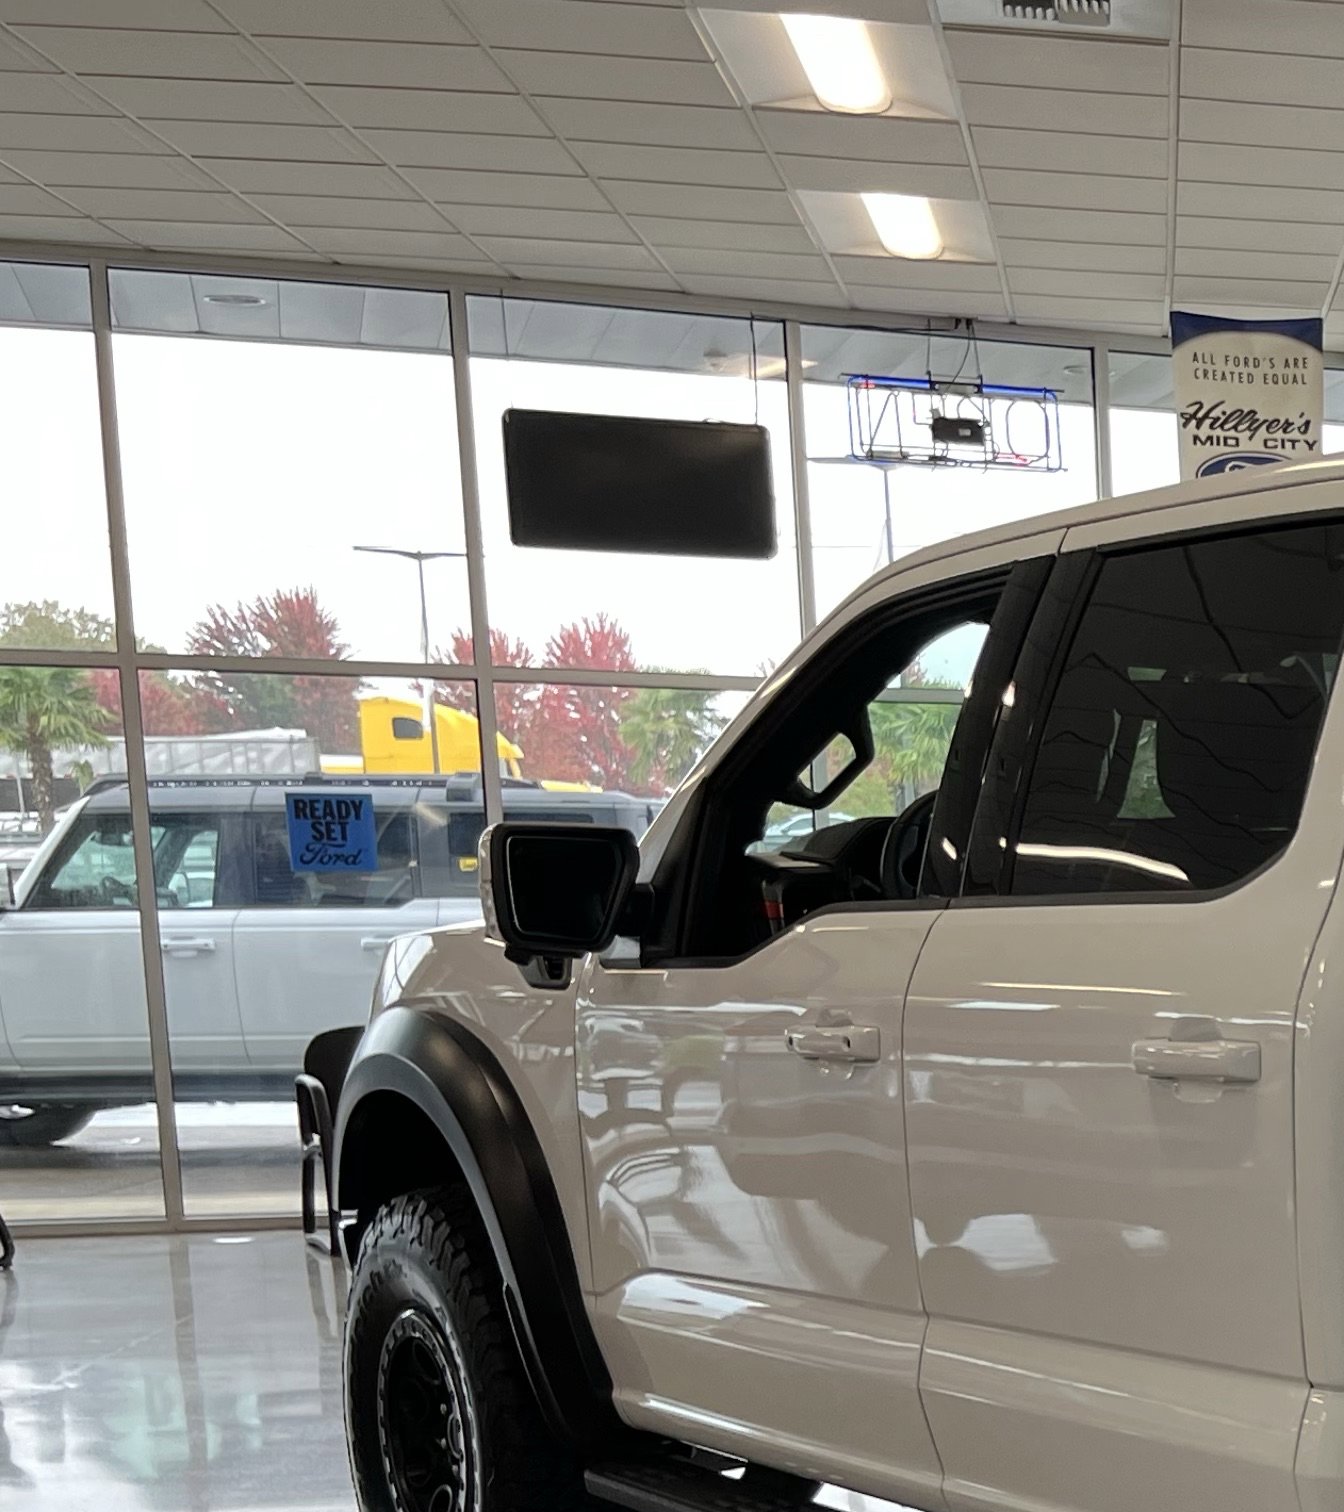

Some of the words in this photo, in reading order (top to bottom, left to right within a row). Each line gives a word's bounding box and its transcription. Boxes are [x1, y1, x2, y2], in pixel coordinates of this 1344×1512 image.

[1192, 351, 1216, 366] ALL
[1224, 354, 1276, 369] FORD'S
[1284, 357, 1308, 369] ARE
[1194, 368, 1255, 385] CREATED
[1263, 373, 1308, 385] EQUAL
[1180, 400, 1311, 440] Hillyer's
[1193, 435, 1240, 448] MID
[1263, 438, 1319, 451] CITY
[293, 798, 363, 820] READY
[311, 821, 349, 842] SET
[300, 842, 363, 866] Ford
